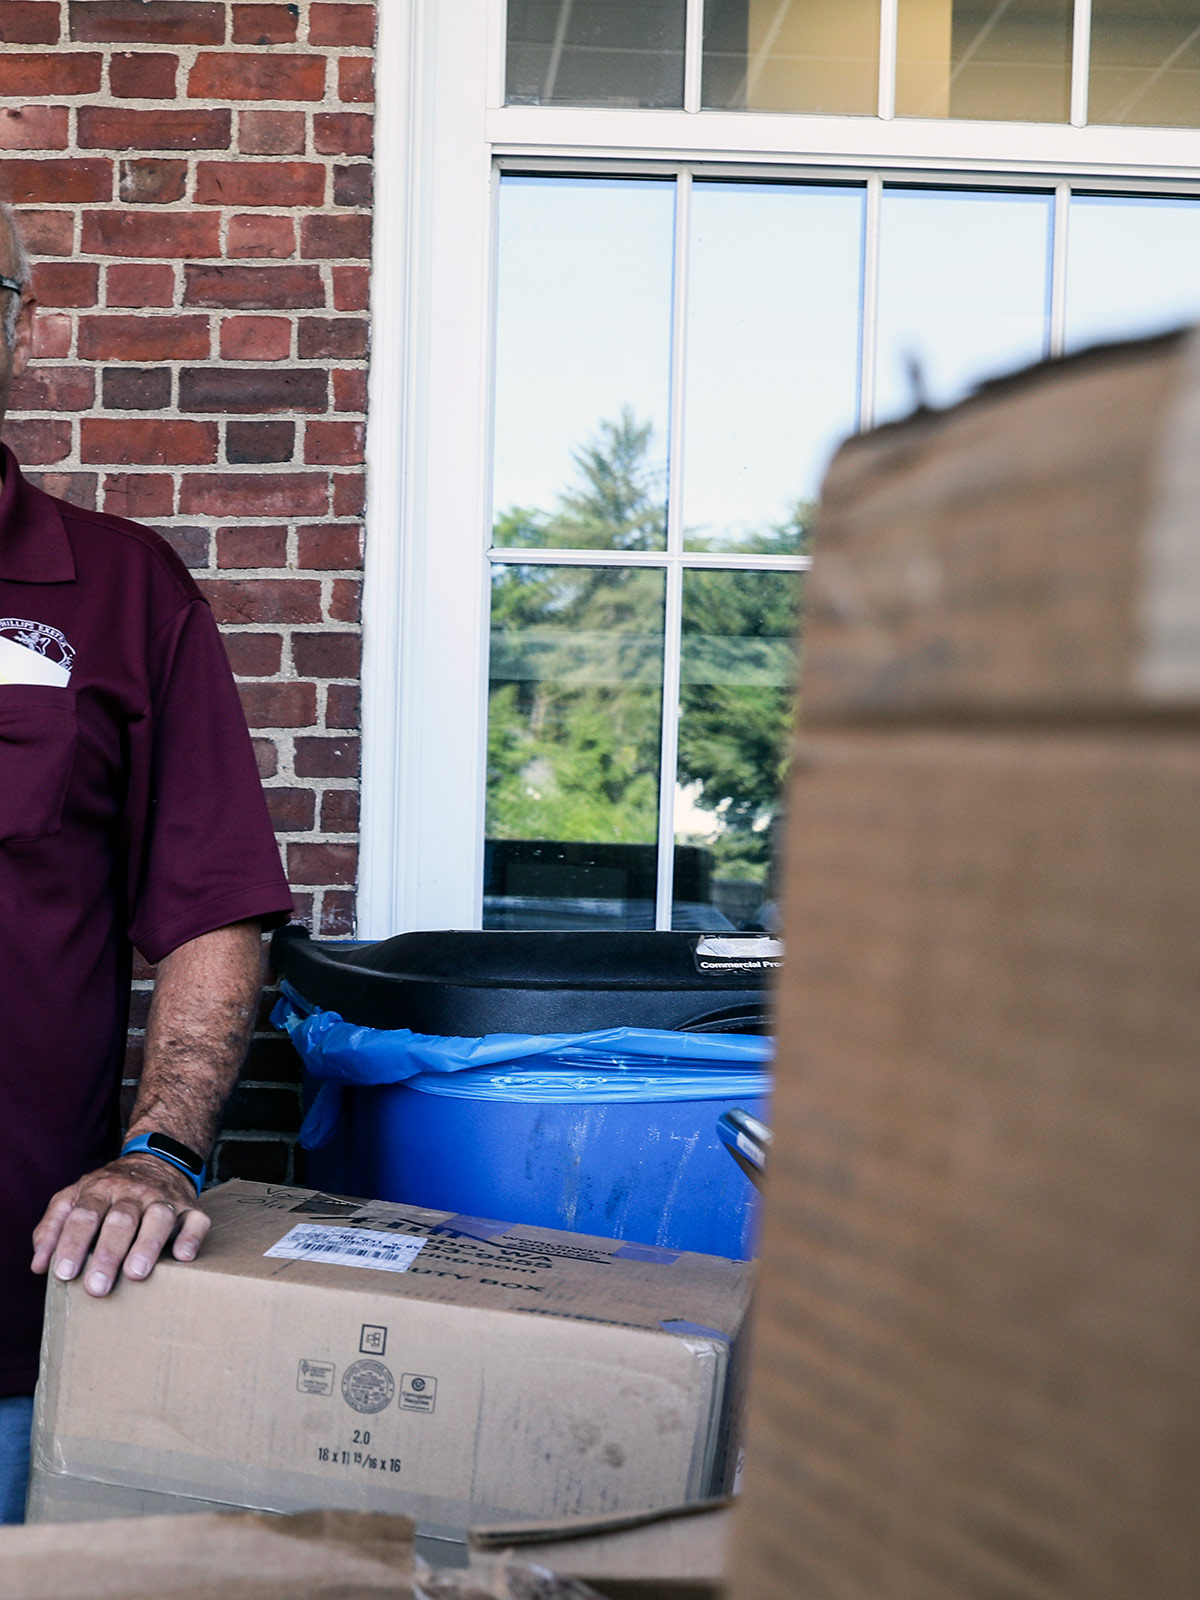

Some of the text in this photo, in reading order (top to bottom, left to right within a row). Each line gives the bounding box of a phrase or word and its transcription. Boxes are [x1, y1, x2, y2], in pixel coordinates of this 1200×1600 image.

[38, 625, 68, 648] EXETER
[700, 961, 784, 969] Commercial Pro
[418, 1252, 537, 1273] ving.com
[422, 1244, 553, 1269] 33-9555
[500, 1249, 553, 1262] WA
[408, 1267, 545, 1292] UTY BOX
[352, 1430, 371, 1445] 2.0
[318, 1447, 329, 1462] 18
[332, 1453, 338, 1462] x
[342, 1451, 350, 1465] 11
[380, 1461, 386, 1470] x
[390, 1458, 401, 1472] 16
